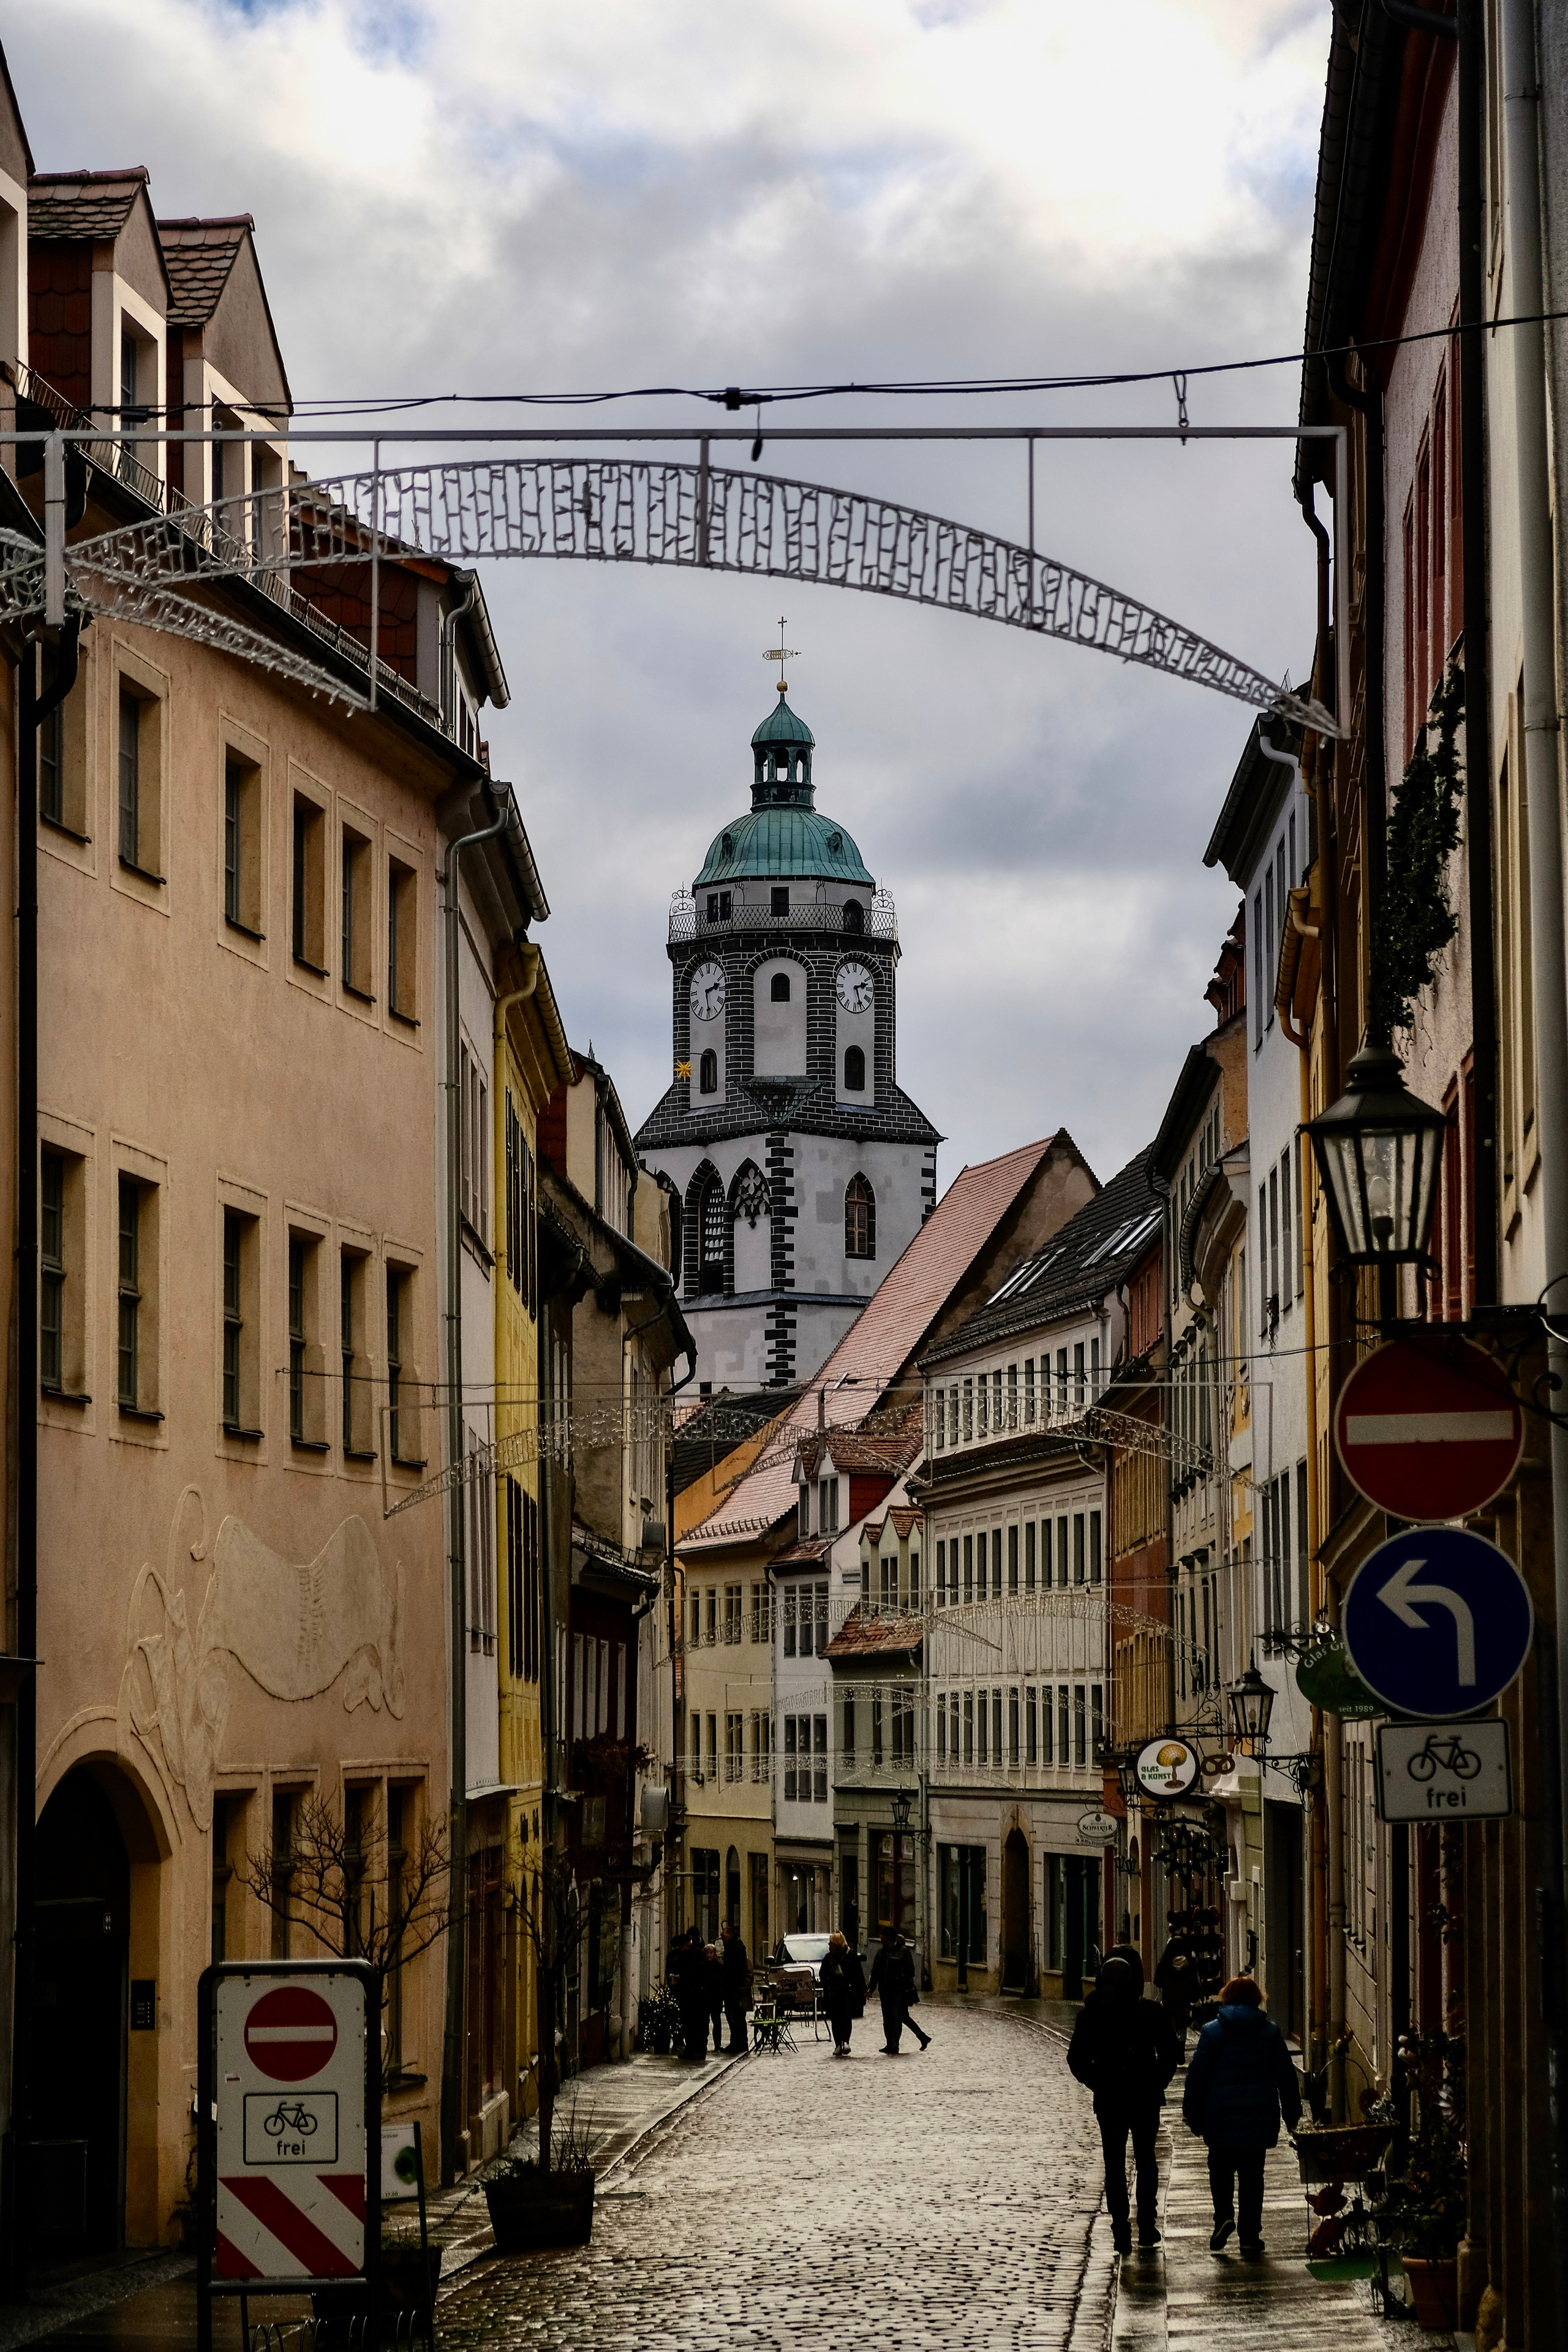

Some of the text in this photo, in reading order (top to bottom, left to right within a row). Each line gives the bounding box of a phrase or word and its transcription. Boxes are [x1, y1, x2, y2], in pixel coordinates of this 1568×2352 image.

[1304, 1648, 1327, 1669] Glas
[1427, 1786, 1466, 1809] frei
[277, 2140, 306, 2156] frei
